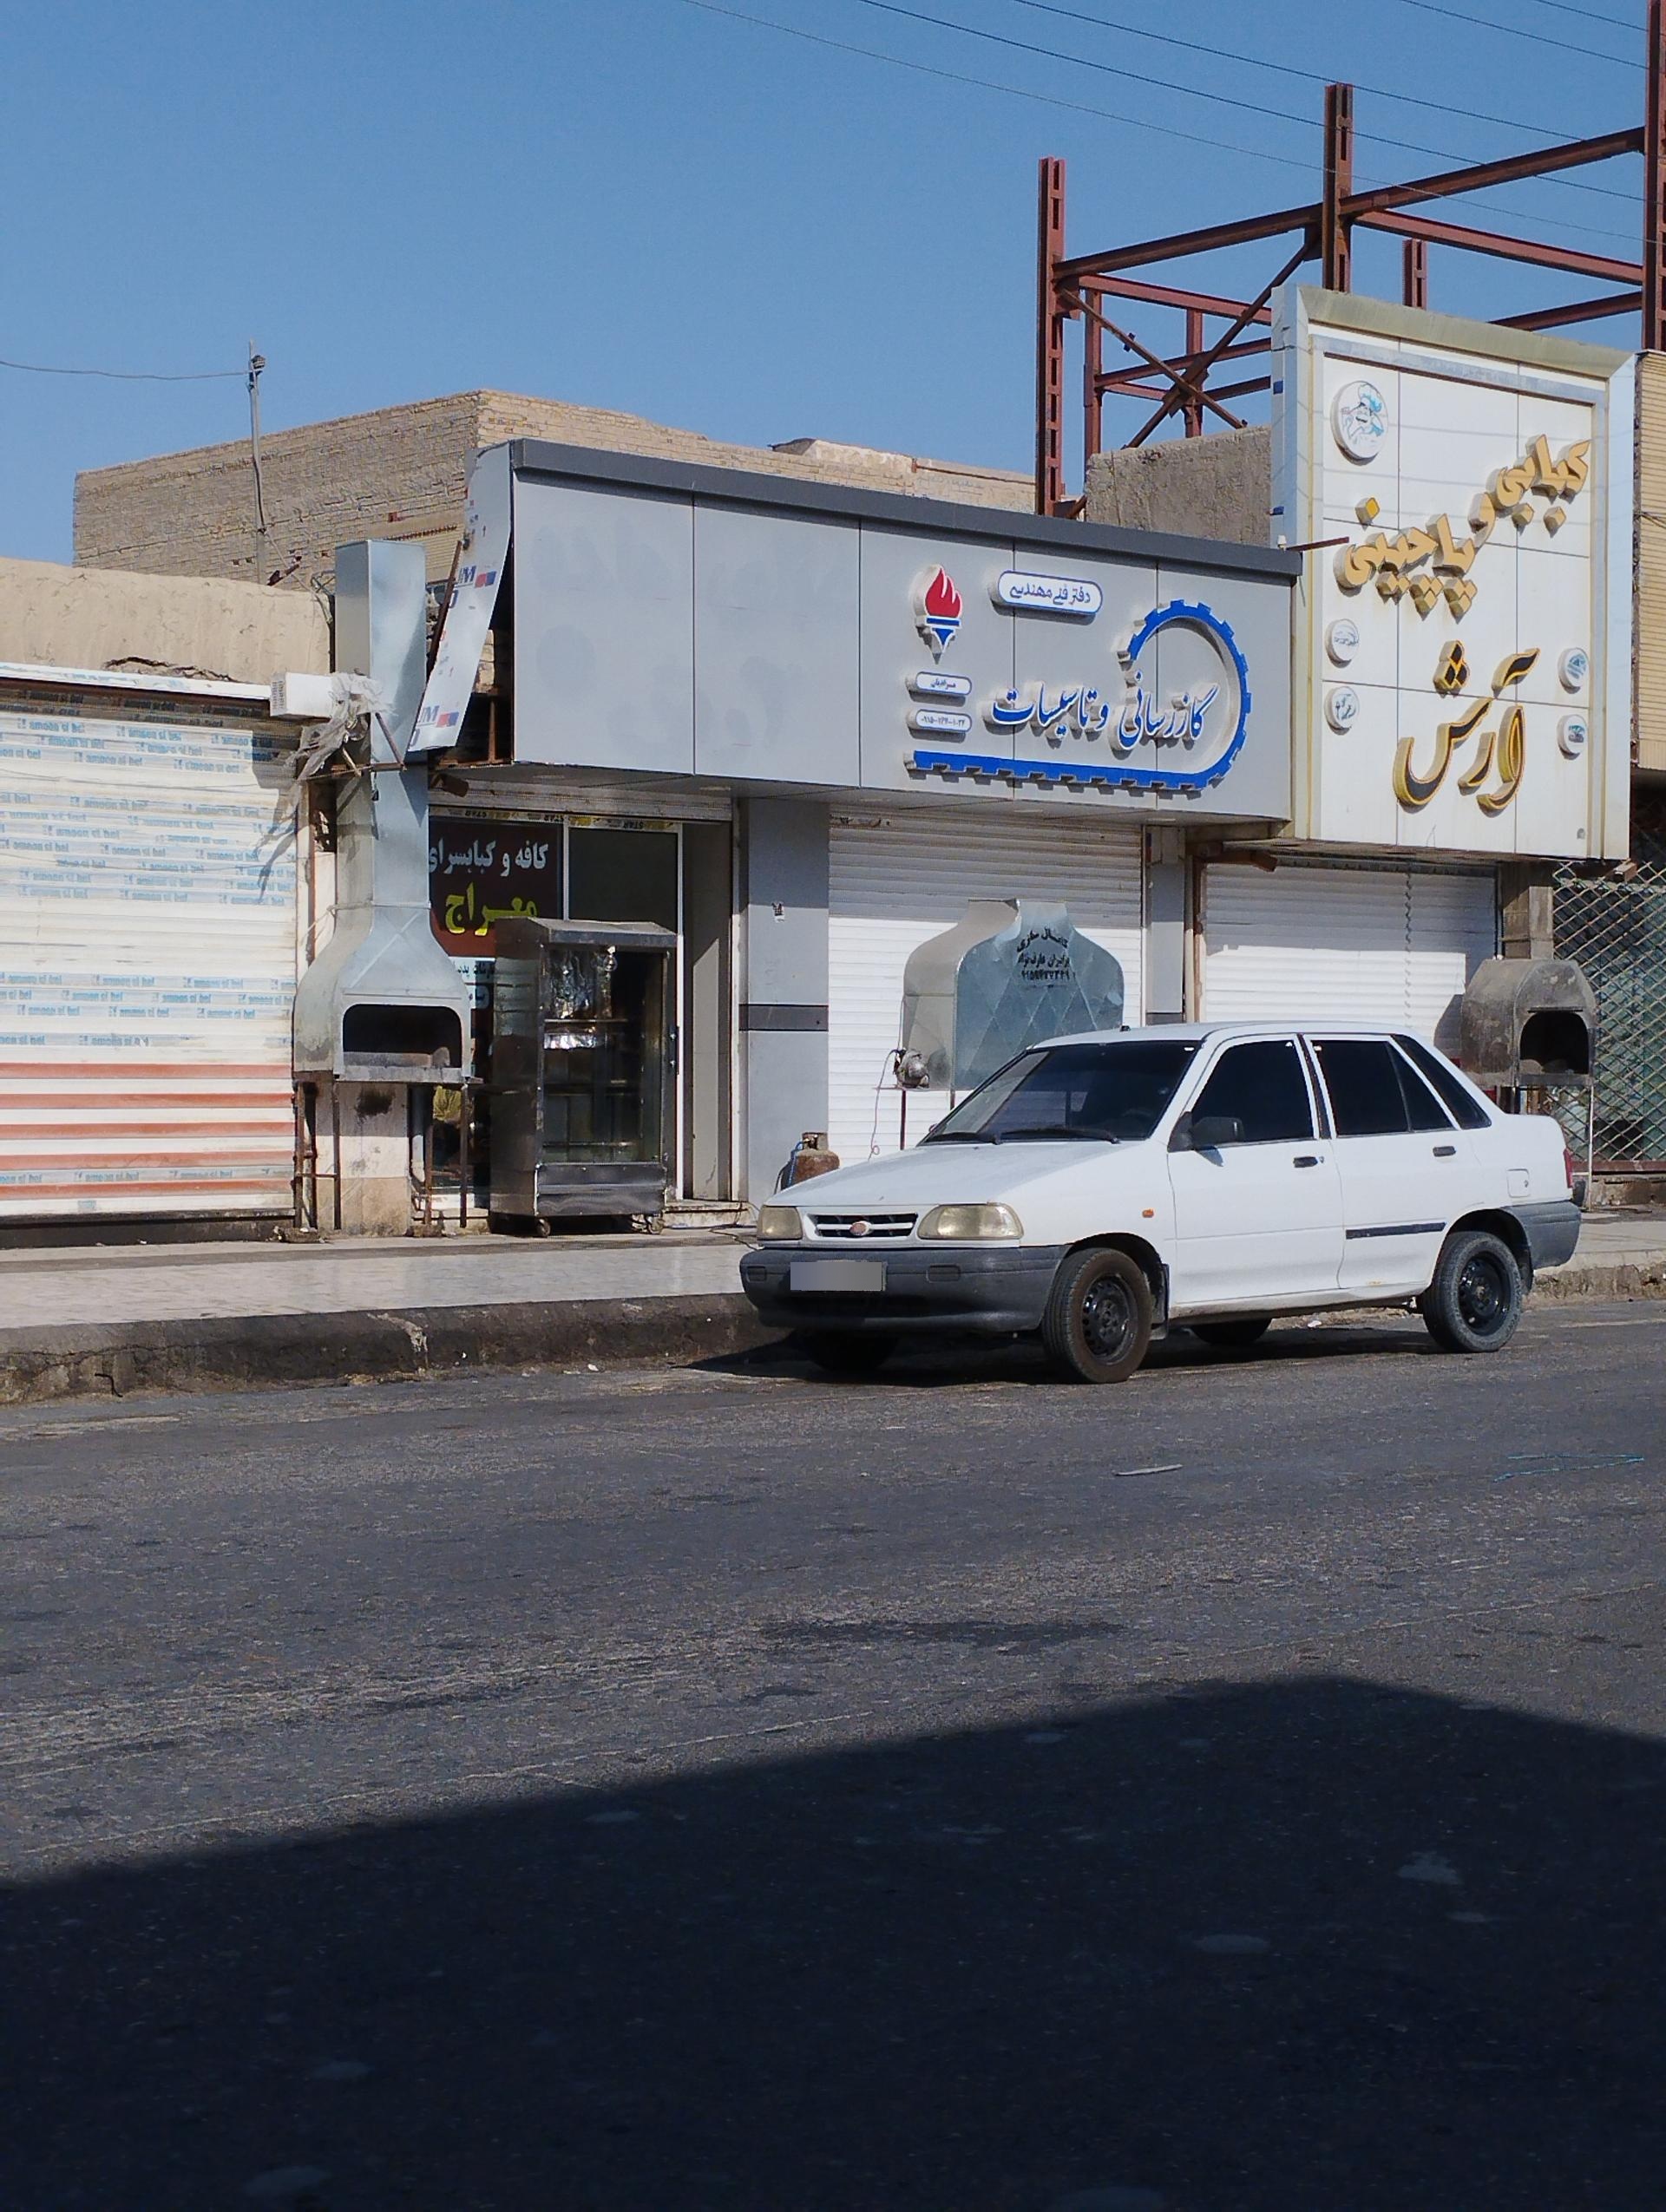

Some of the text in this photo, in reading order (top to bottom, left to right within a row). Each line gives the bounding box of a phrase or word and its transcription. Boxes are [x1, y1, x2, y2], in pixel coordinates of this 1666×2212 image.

[1494, 434, 1591, 524] کبابی
[1472, 492, 1497, 550] و
[1009, 582, 1091, 605] دفتر فنی مهندسی
[991, 670, 1220, 750] گازرسانی و تاسیسات
[500, 853, 510, 877] و
[515, 839, 548, 869] کافه
